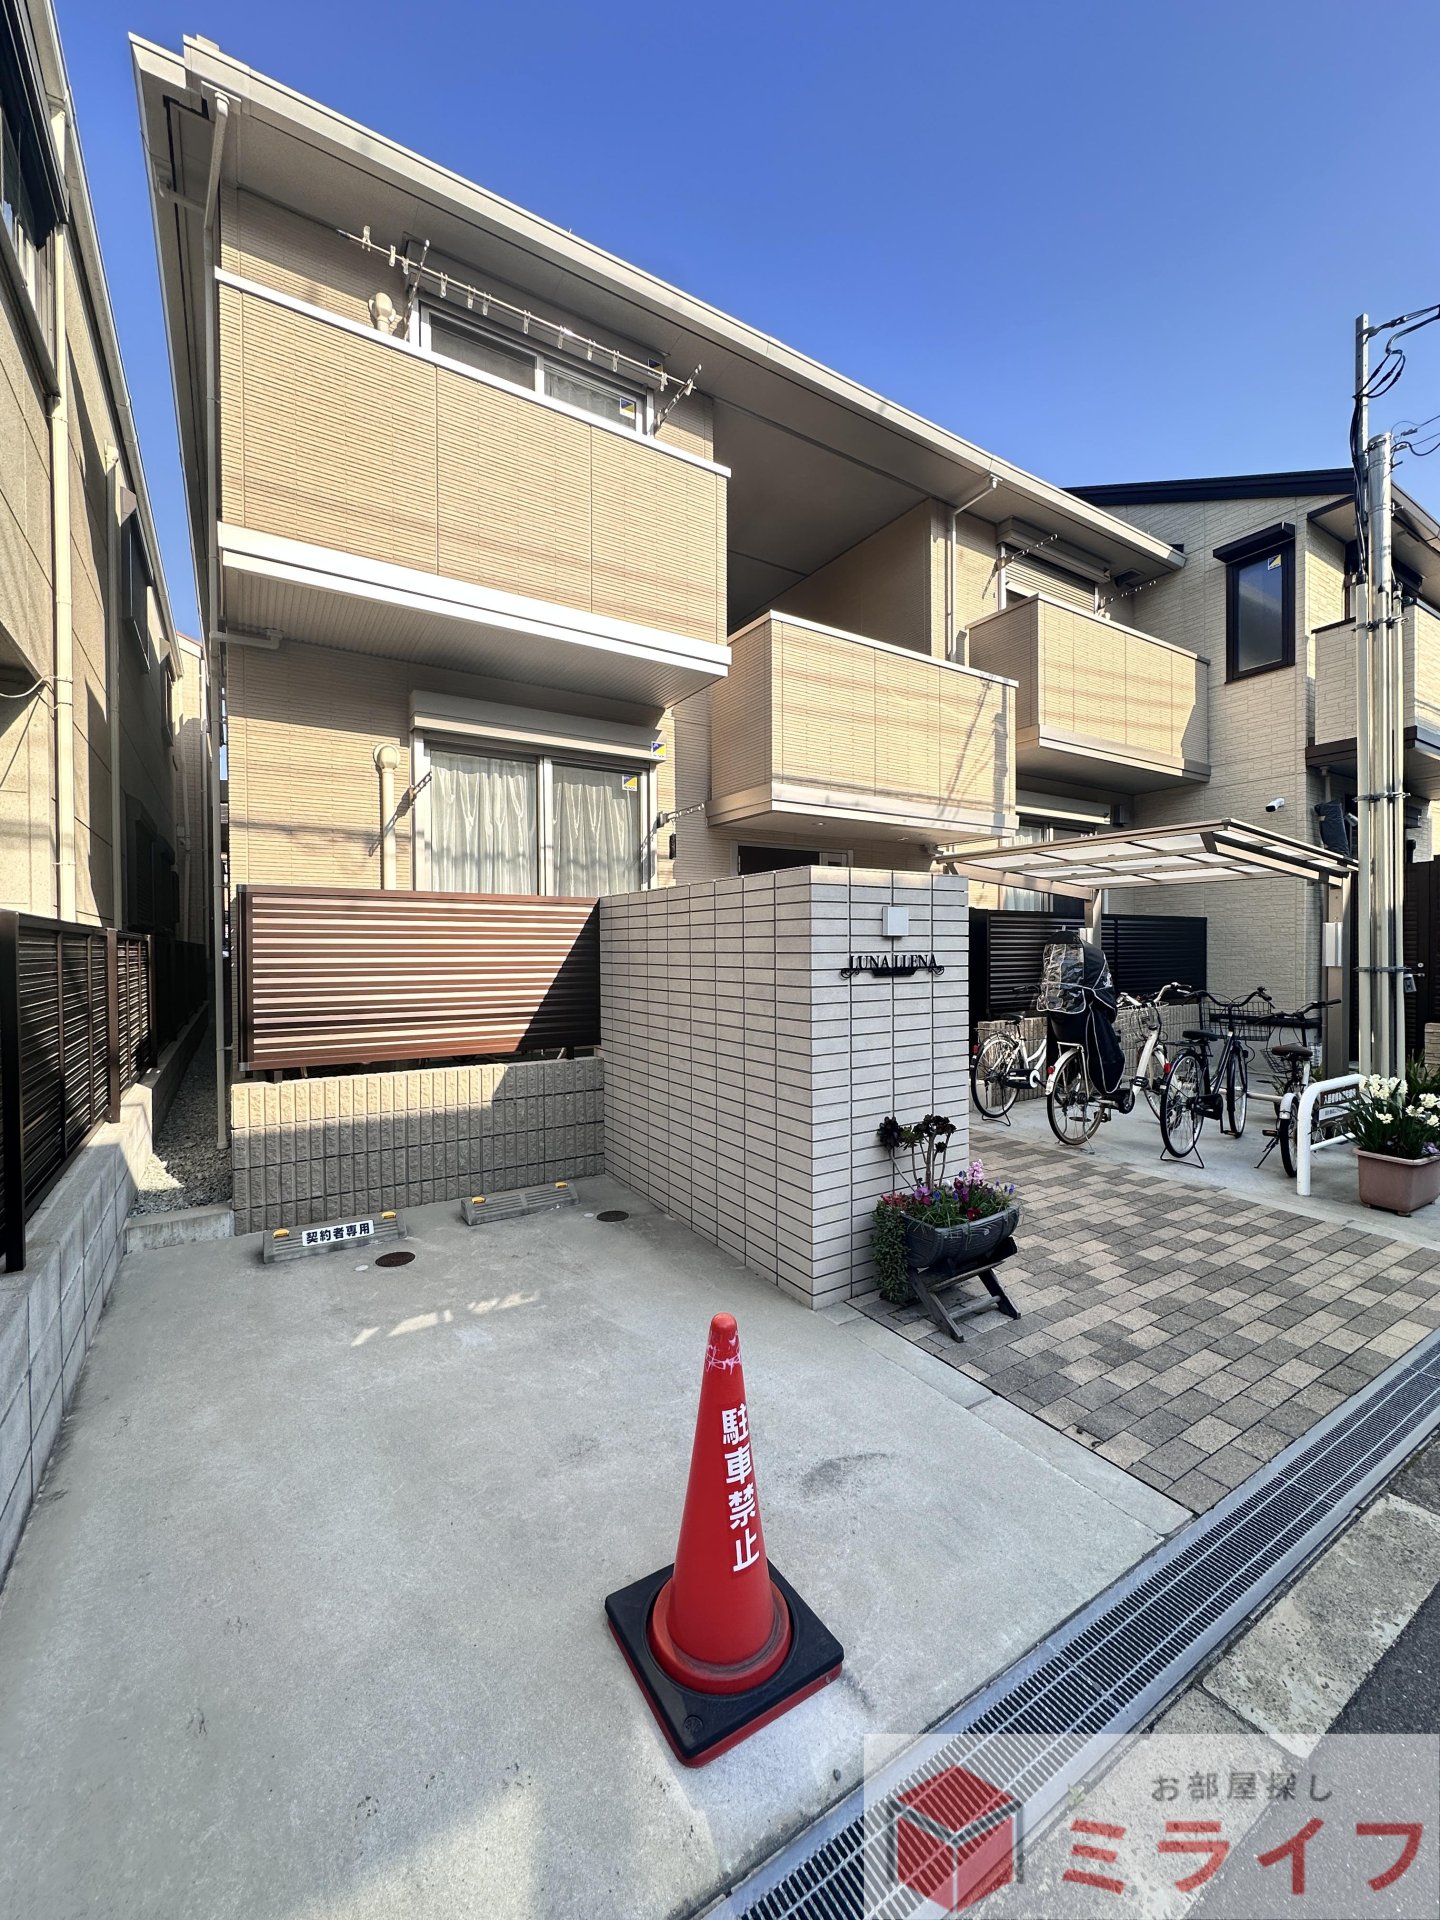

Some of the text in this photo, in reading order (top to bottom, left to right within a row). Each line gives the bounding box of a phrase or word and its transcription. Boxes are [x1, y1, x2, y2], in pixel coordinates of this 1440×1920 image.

[850, 953, 937, 969] LUNA LLENA
[306, 1222, 370, 1245] 契約者専用
[721, 1403, 760, 1572] 駐車禁止
